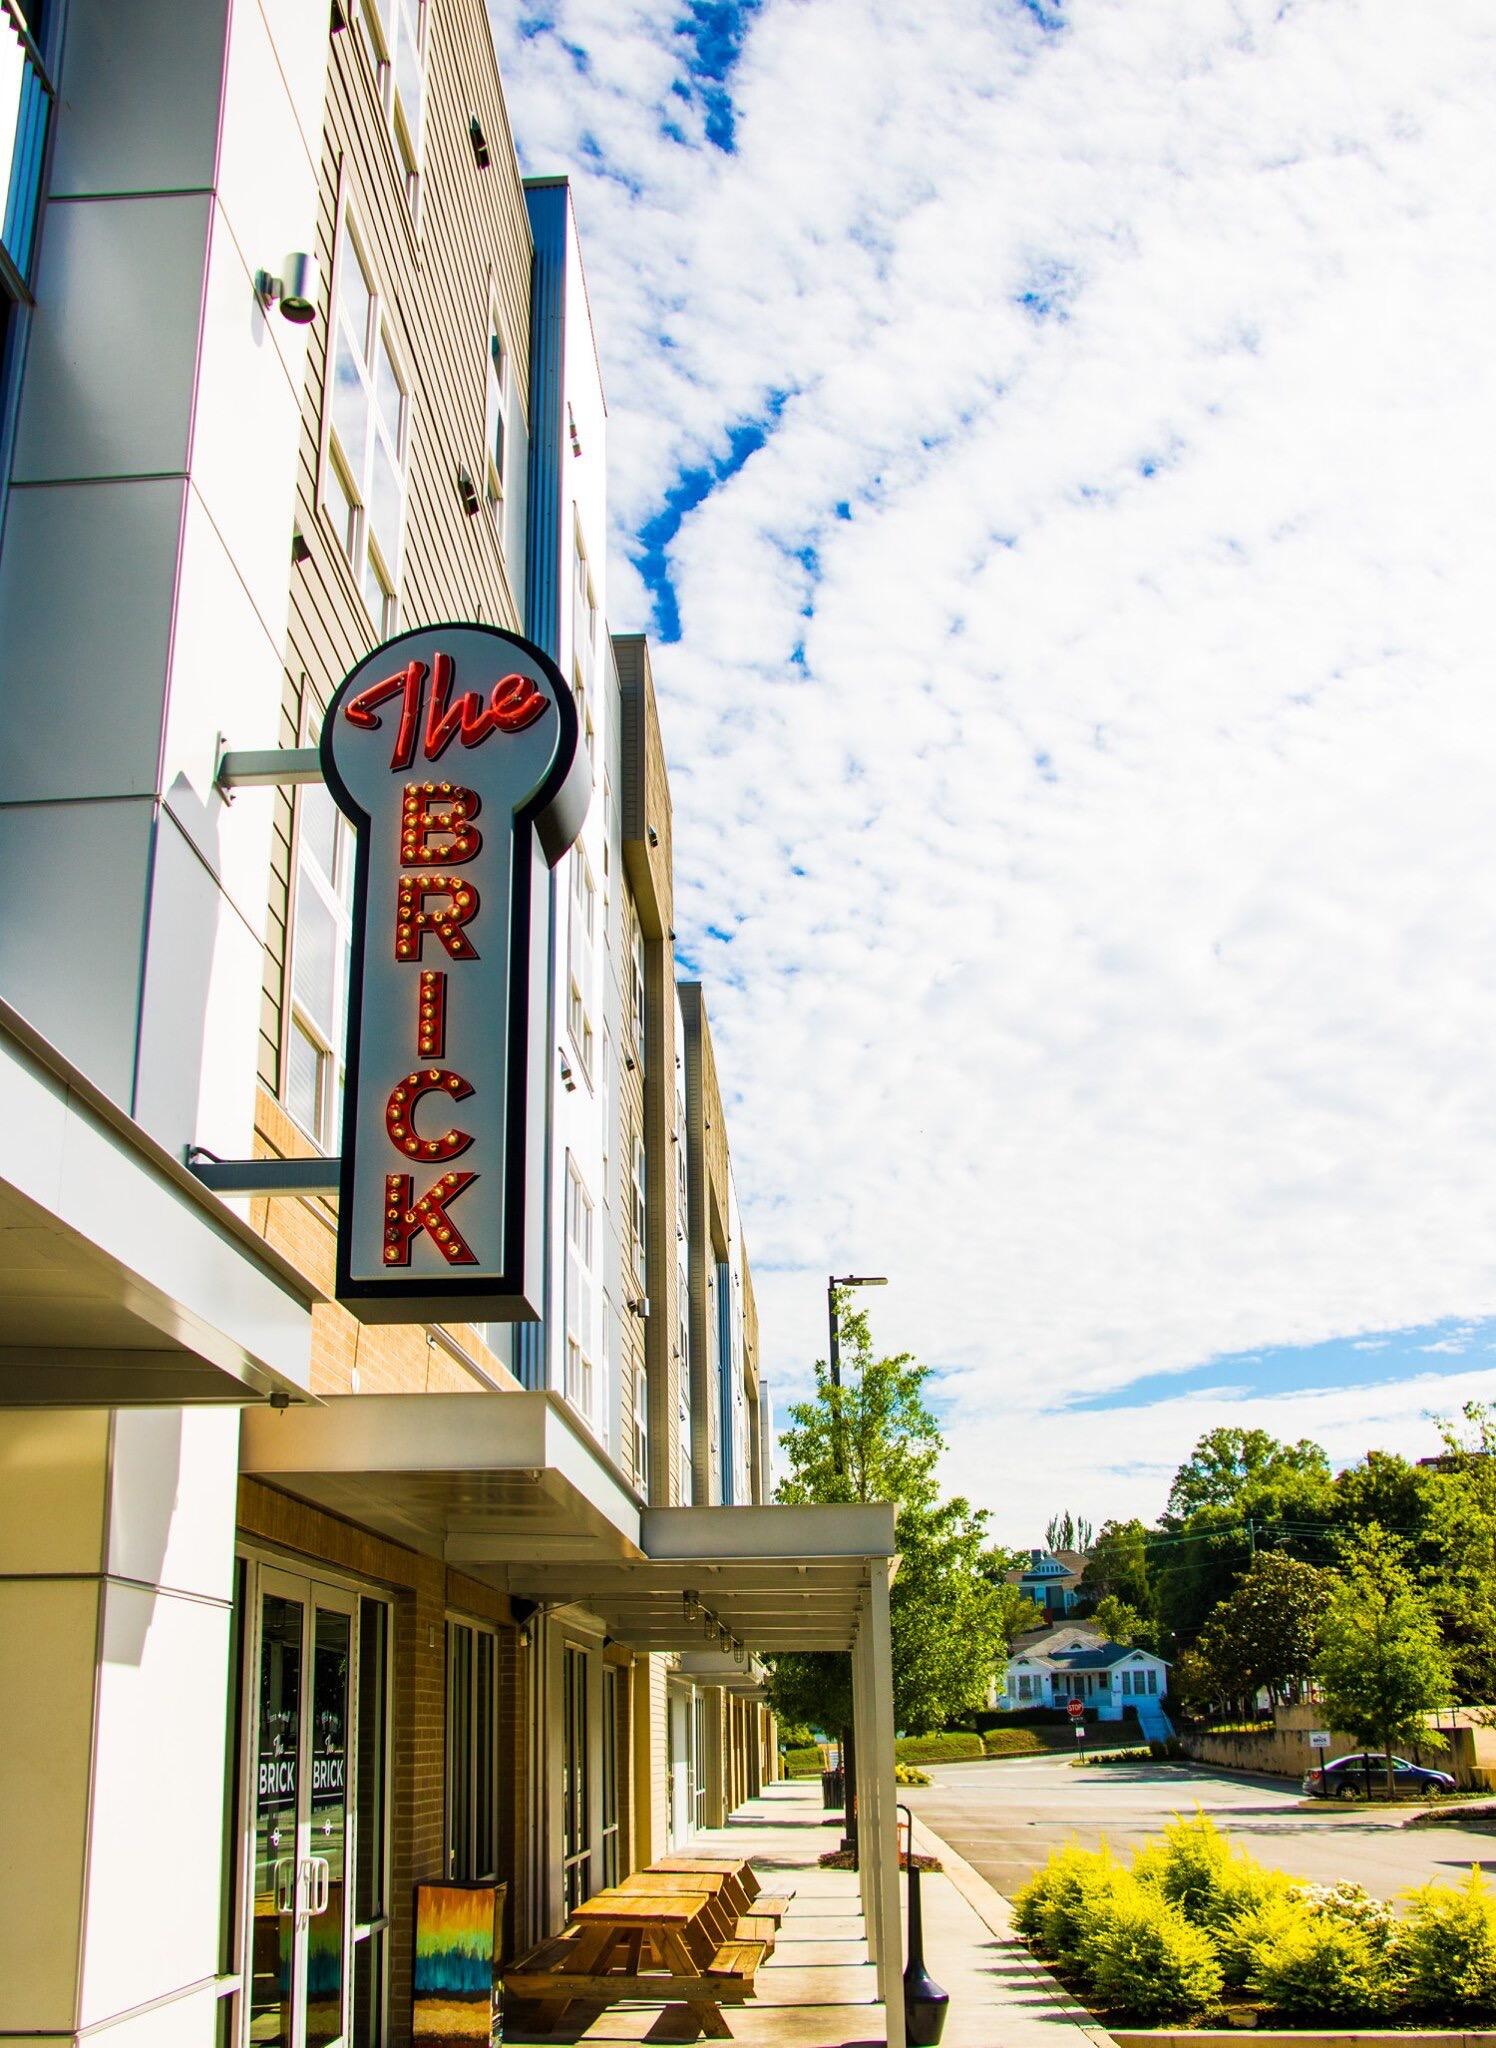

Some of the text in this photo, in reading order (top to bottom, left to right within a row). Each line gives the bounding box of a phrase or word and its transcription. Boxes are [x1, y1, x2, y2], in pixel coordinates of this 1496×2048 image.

[344, 652, 549, 771] The
[383, 783, 481, 1264] BRICK
[1068, 1703, 1082, 1712] STOP
[259, 1761, 295, 1795] BRICK
[313, 1760, 344, 1789] BRICK
